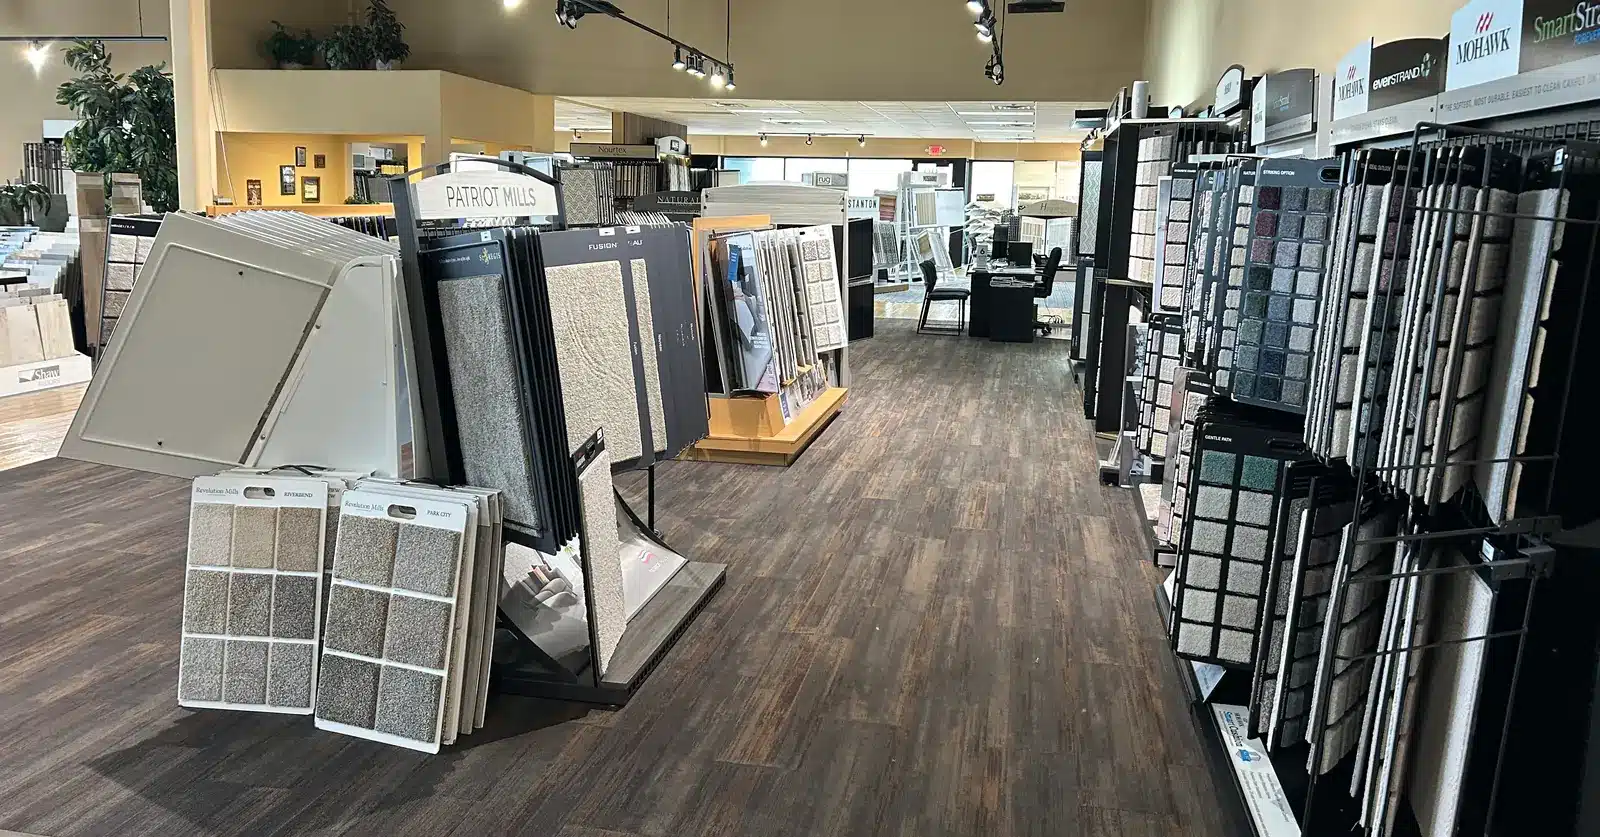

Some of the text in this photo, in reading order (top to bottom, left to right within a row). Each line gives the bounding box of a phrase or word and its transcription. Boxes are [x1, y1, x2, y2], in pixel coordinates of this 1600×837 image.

[1456, 27, 1511, 65] MOHAWK
[1338, 78, 1364, 101] MOHAWK
[818, 175, 831, 185] rug
[446, 186, 536, 207] PATRIOT MILLS
[848, 199, 877, 208] STANTON
[588, 242, 618, 250] FUSION
[35, 368, 60, 380] Shaw
[225, 487, 239, 495] Mills
